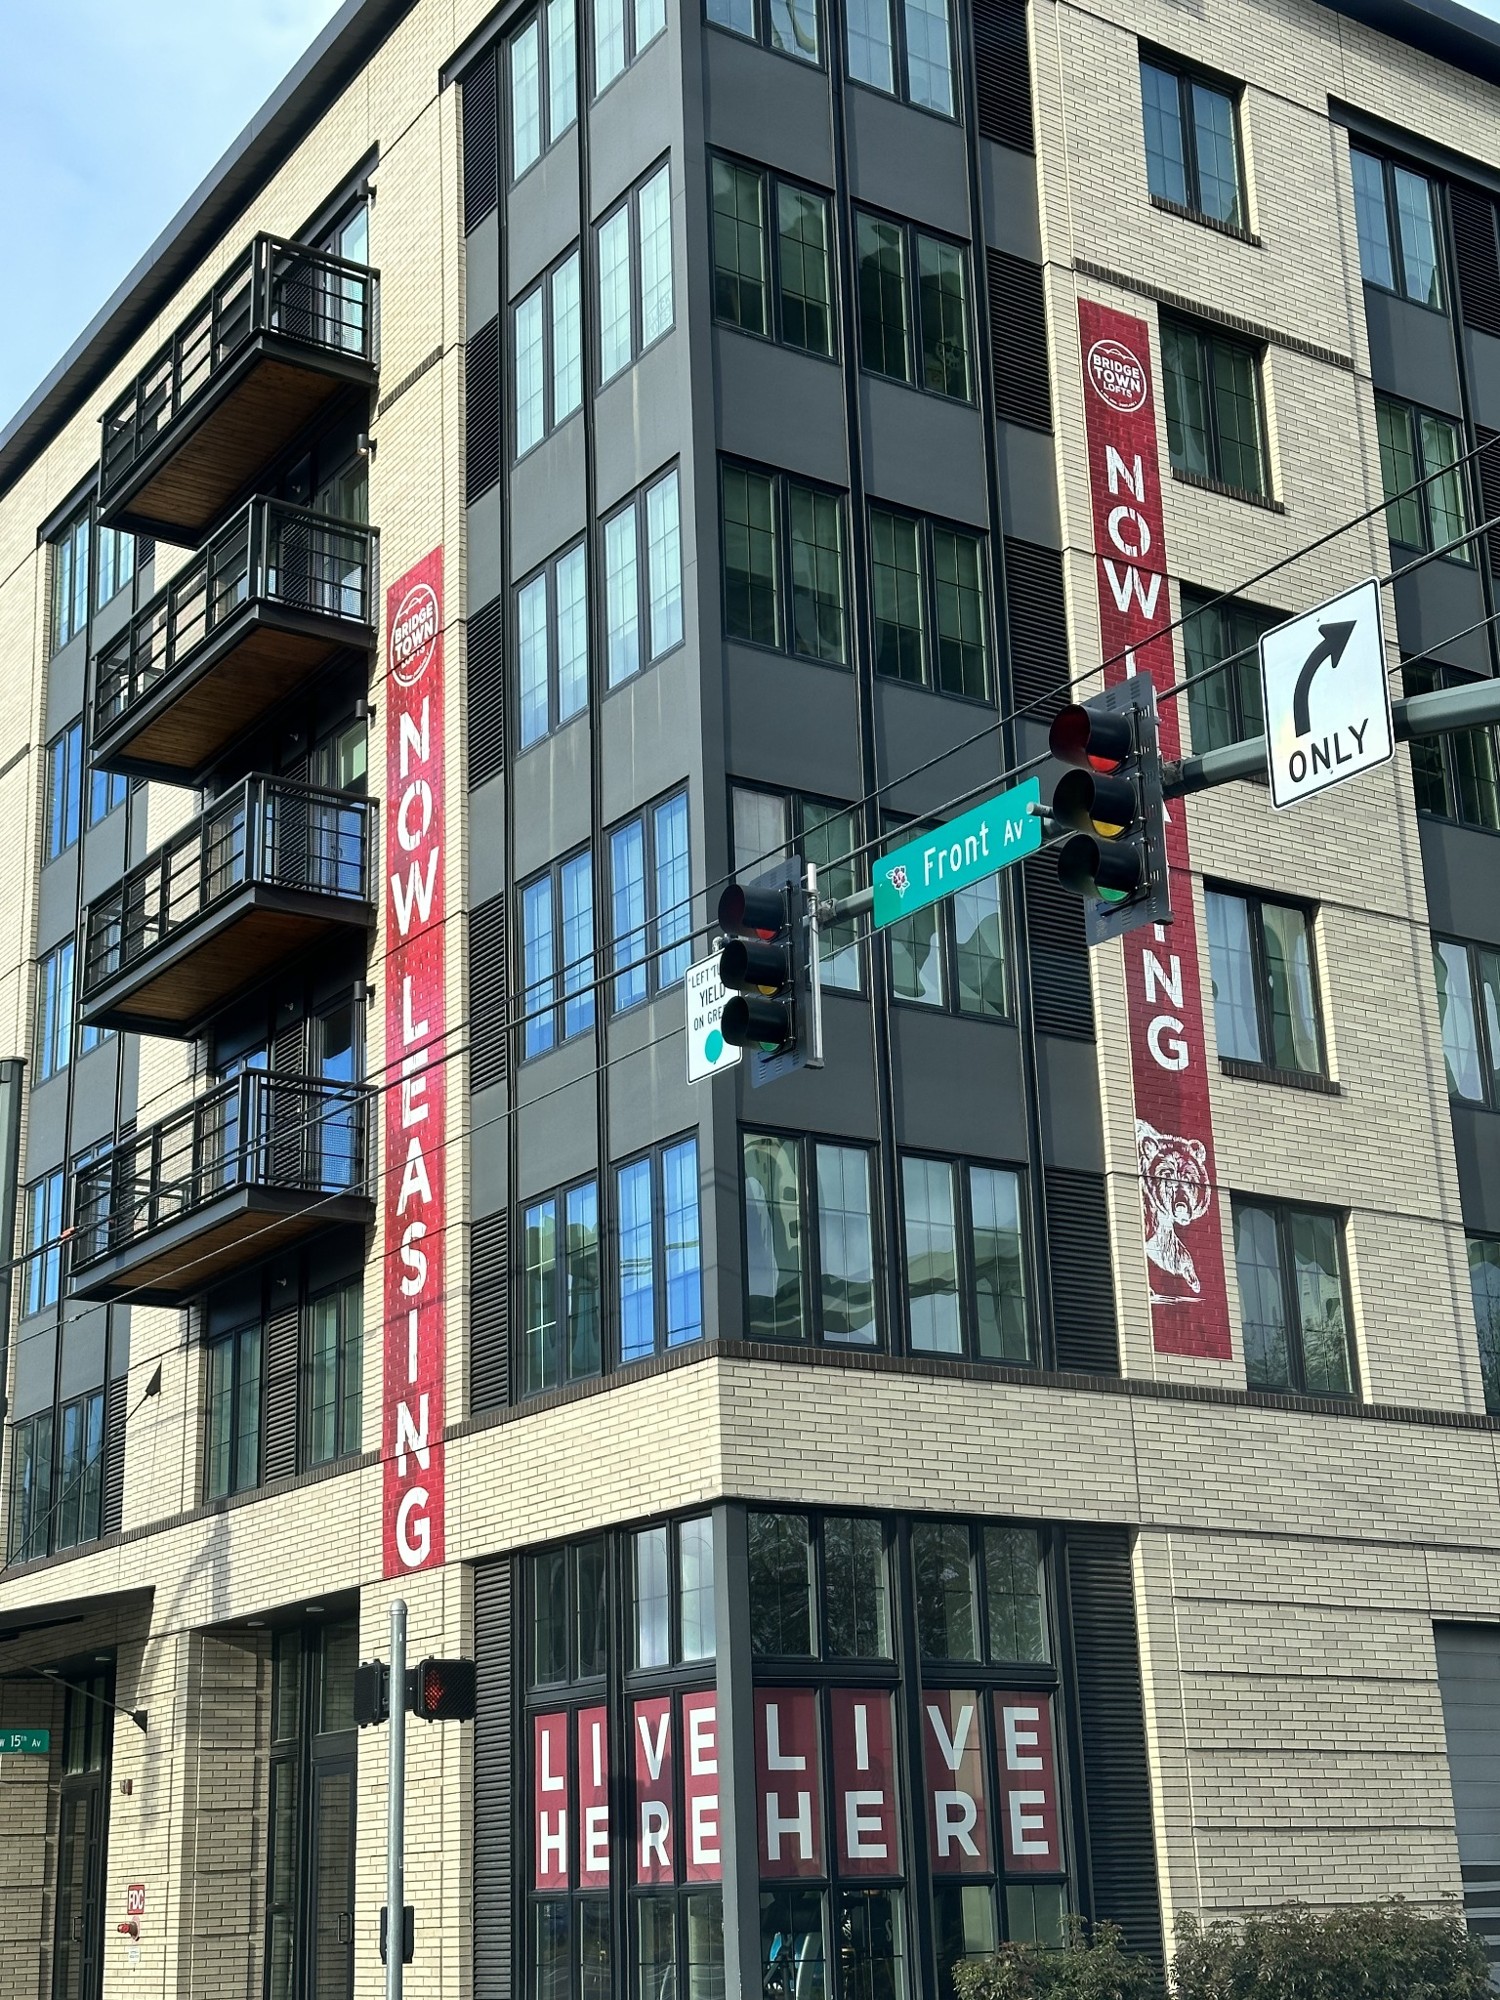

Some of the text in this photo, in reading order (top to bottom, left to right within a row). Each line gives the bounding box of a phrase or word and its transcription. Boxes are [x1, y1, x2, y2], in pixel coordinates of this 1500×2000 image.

[1093, 353, 1140, 379] BRIDGE
[1094, 365, 1141, 393] TOWN
[1103, 380, 1133, 398] LOFTS
[1102, 444, 1162, 620] NOW
[394, 601, 433, 644] BRIDGE
[395, 617, 434, 661] TOWN
[1288, 718, 1369, 783] ONLY
[390, 694, 440, 936] NOW
[923, 818, 1023, 887] Front Av
[692, 968, 710, 989] LEFT
[699, 981, 726, 1008] YIELD
[693, 1006, 722, 1031] ON GRE
[395, 975, 432, 1567] LEASING
[31, 1738, 42, 1748] Av
[540, 1706, 719, 1792] LIVE
[765, 1703, 1043, 1771] LIVE
[540, 1794, 721, 1875] HERE
[766, 1790, 1049, 1861] HERE
[128, 1889, 144, 1911] FDC
